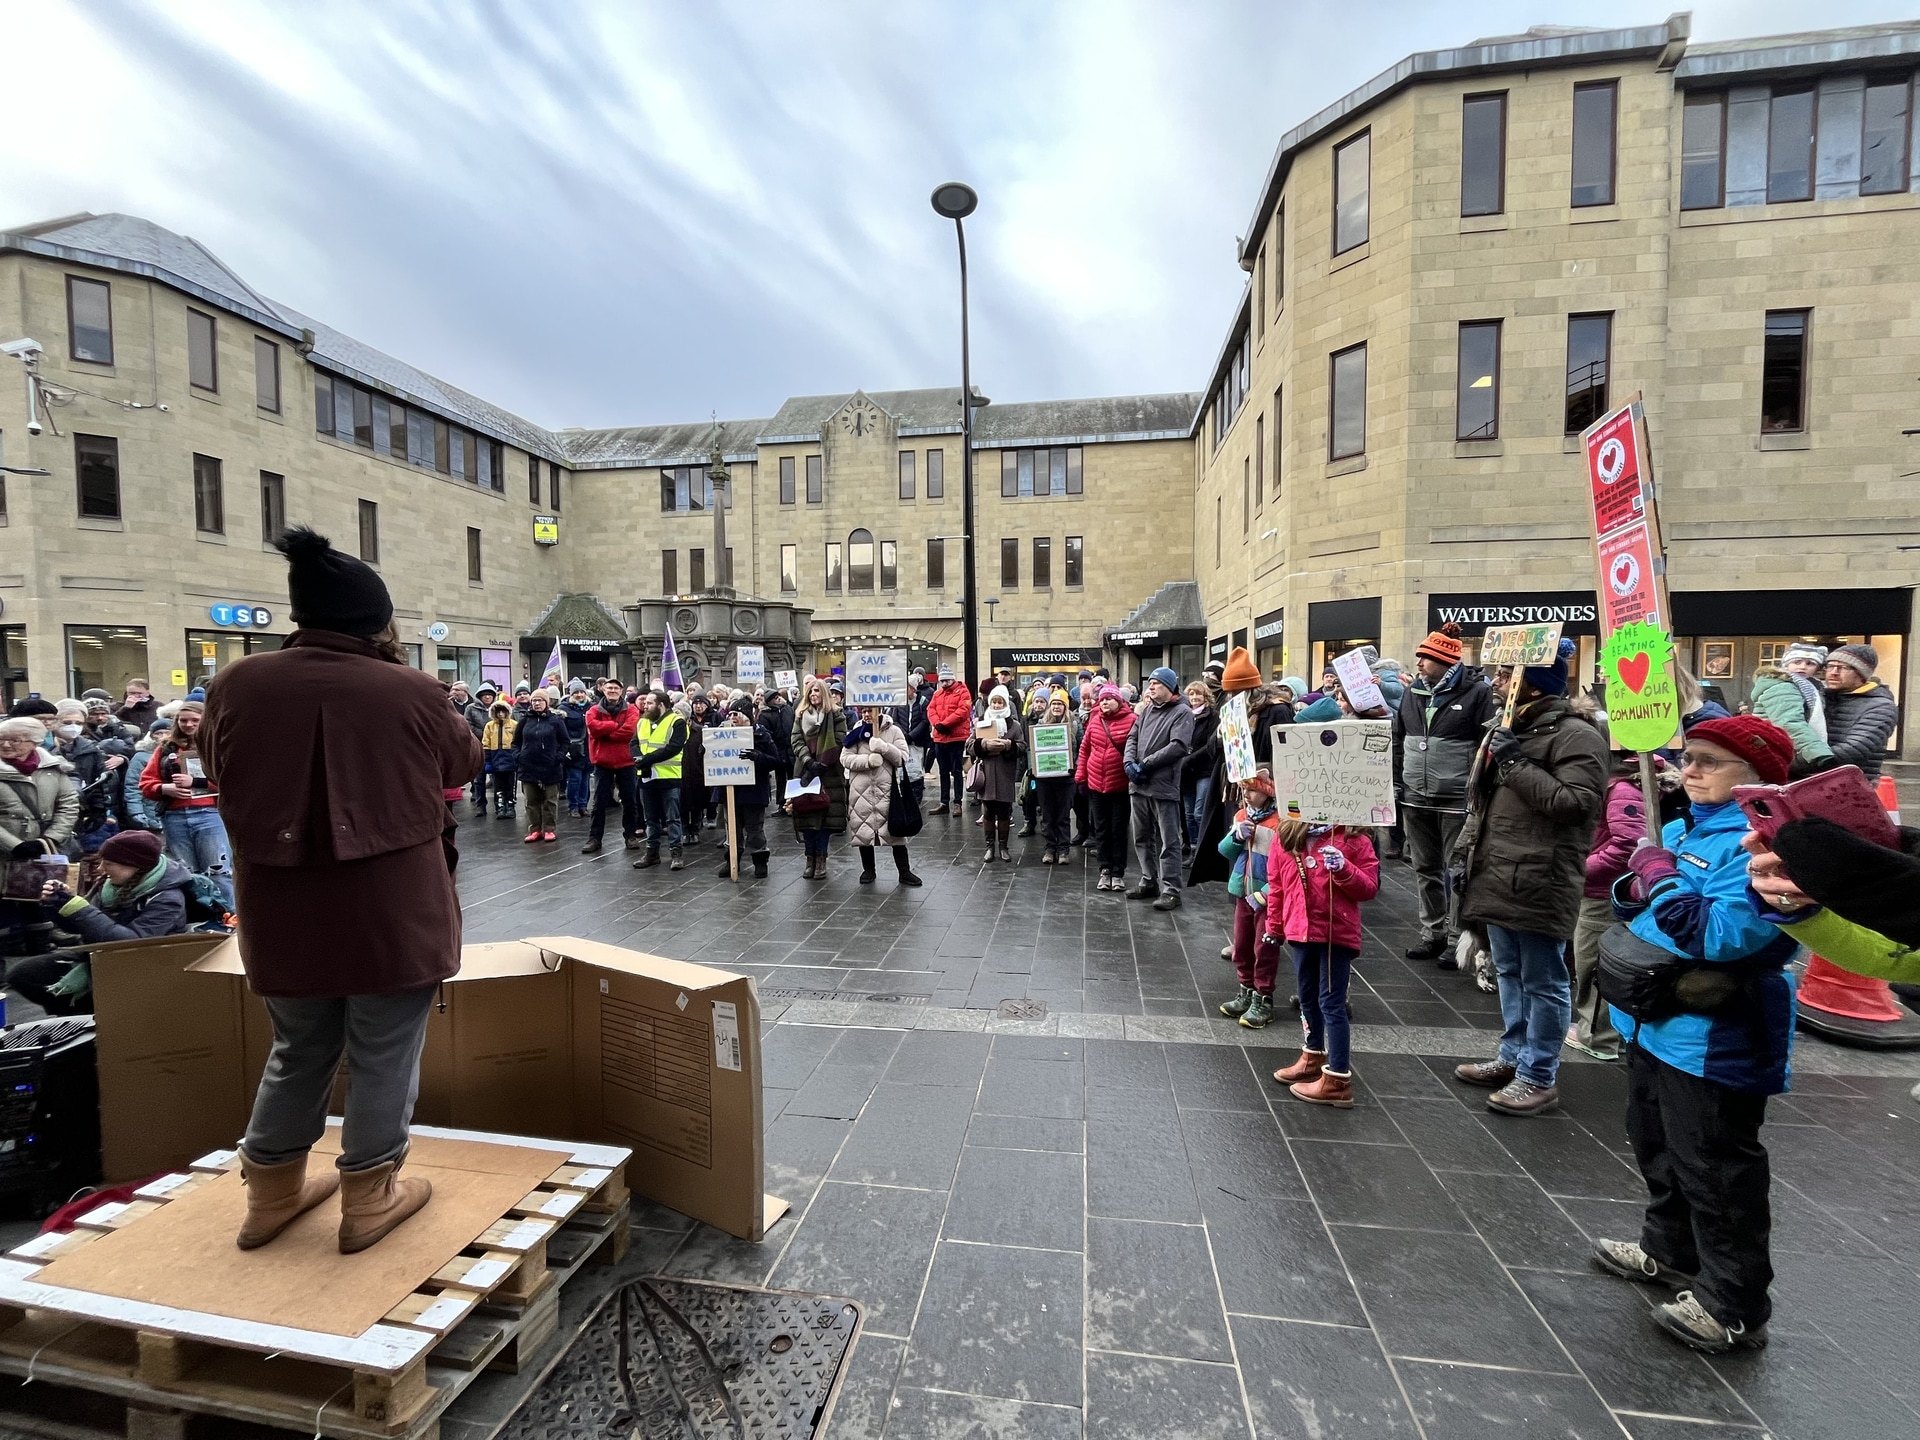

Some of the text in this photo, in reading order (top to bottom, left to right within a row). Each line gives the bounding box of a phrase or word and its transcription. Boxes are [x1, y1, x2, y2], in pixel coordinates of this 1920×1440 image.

[217, 607, 269, 624] TSB
[1437, 605, 1597, 623] WATERSTONES
[1484, 628, 1549, 649] SAVE OUR
[1616, 627, 1639, 642] THE
[489, 639, 513, 647] tsb.co.uk
[1612, 640, 1655, 656] BEATING
[861, 656, 886, 665] SAVE
[1012, 653, 1080, 662] WATERSTONES
[858, 675, 892, 684] SCONE
[853, 693, 897, 703] LIBRARY
[1614, 681, 1670, 700] OF OUR
[1610, 702, 1672, 721] COMMUNITY
[712, 731, 738, 740] SAVE
[1291, 726, 1359, 750] STOP
[1283, 751, 1358, 768] TRYING
[708, 767, 750, 777] LIBRARY
[1311, 768, 1350, 785] TAKE
[1295, 781, 1332, 796] OUR
[1301, 795, 1362, 813] LIBRARY
